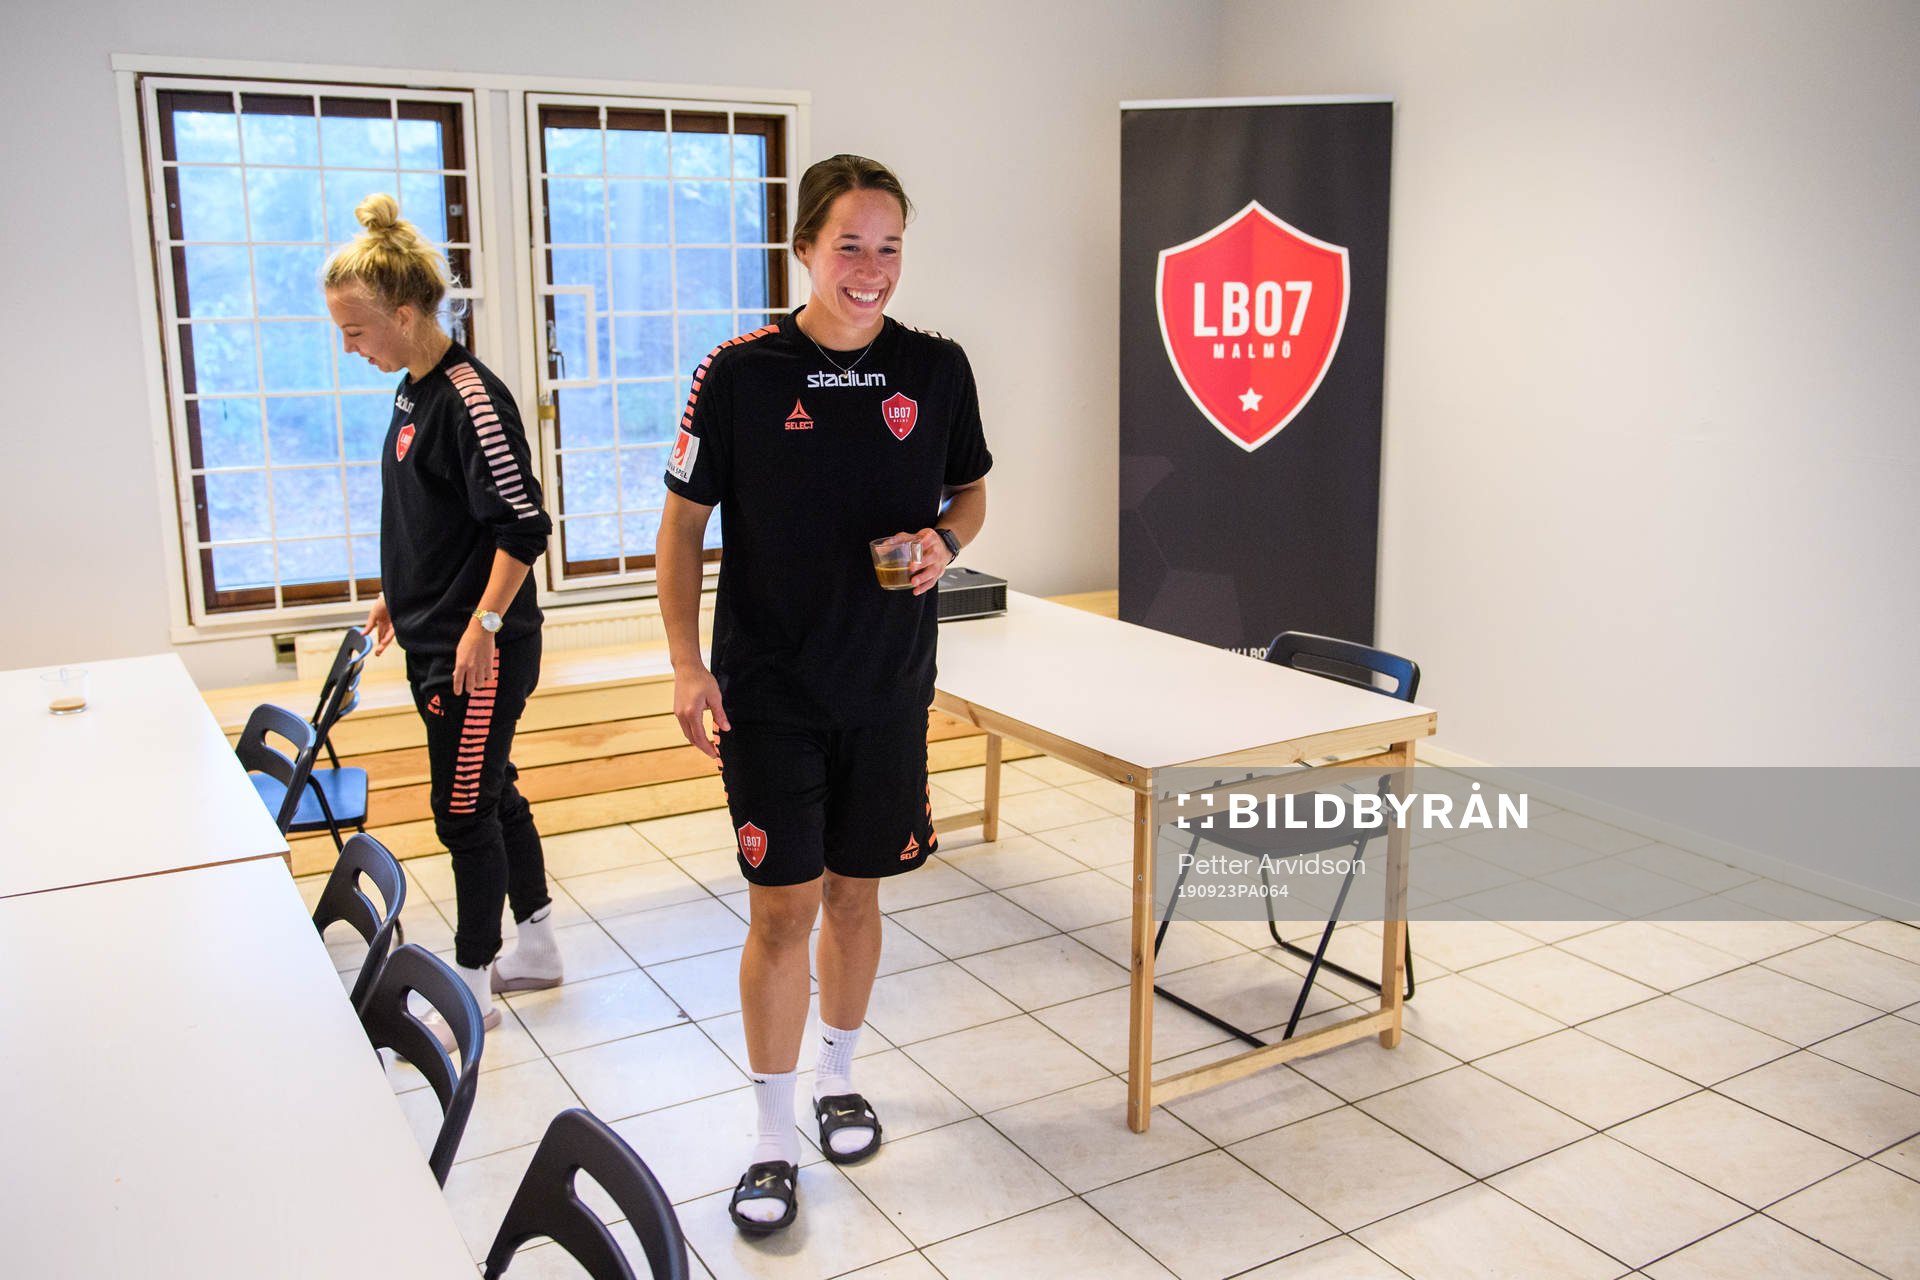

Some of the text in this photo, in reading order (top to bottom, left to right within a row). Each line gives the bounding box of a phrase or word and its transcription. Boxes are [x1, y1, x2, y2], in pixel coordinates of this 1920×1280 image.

[1193, 280, 1313, 337] LB07
[1212, 340, 1292, 359] MALMÖ
[807, 370, 887, 388] stadium
[888, 406, 911, 419] LB07
[784, 421, 814, 430] SELECT
[742, 834, 762, 847] LB07
